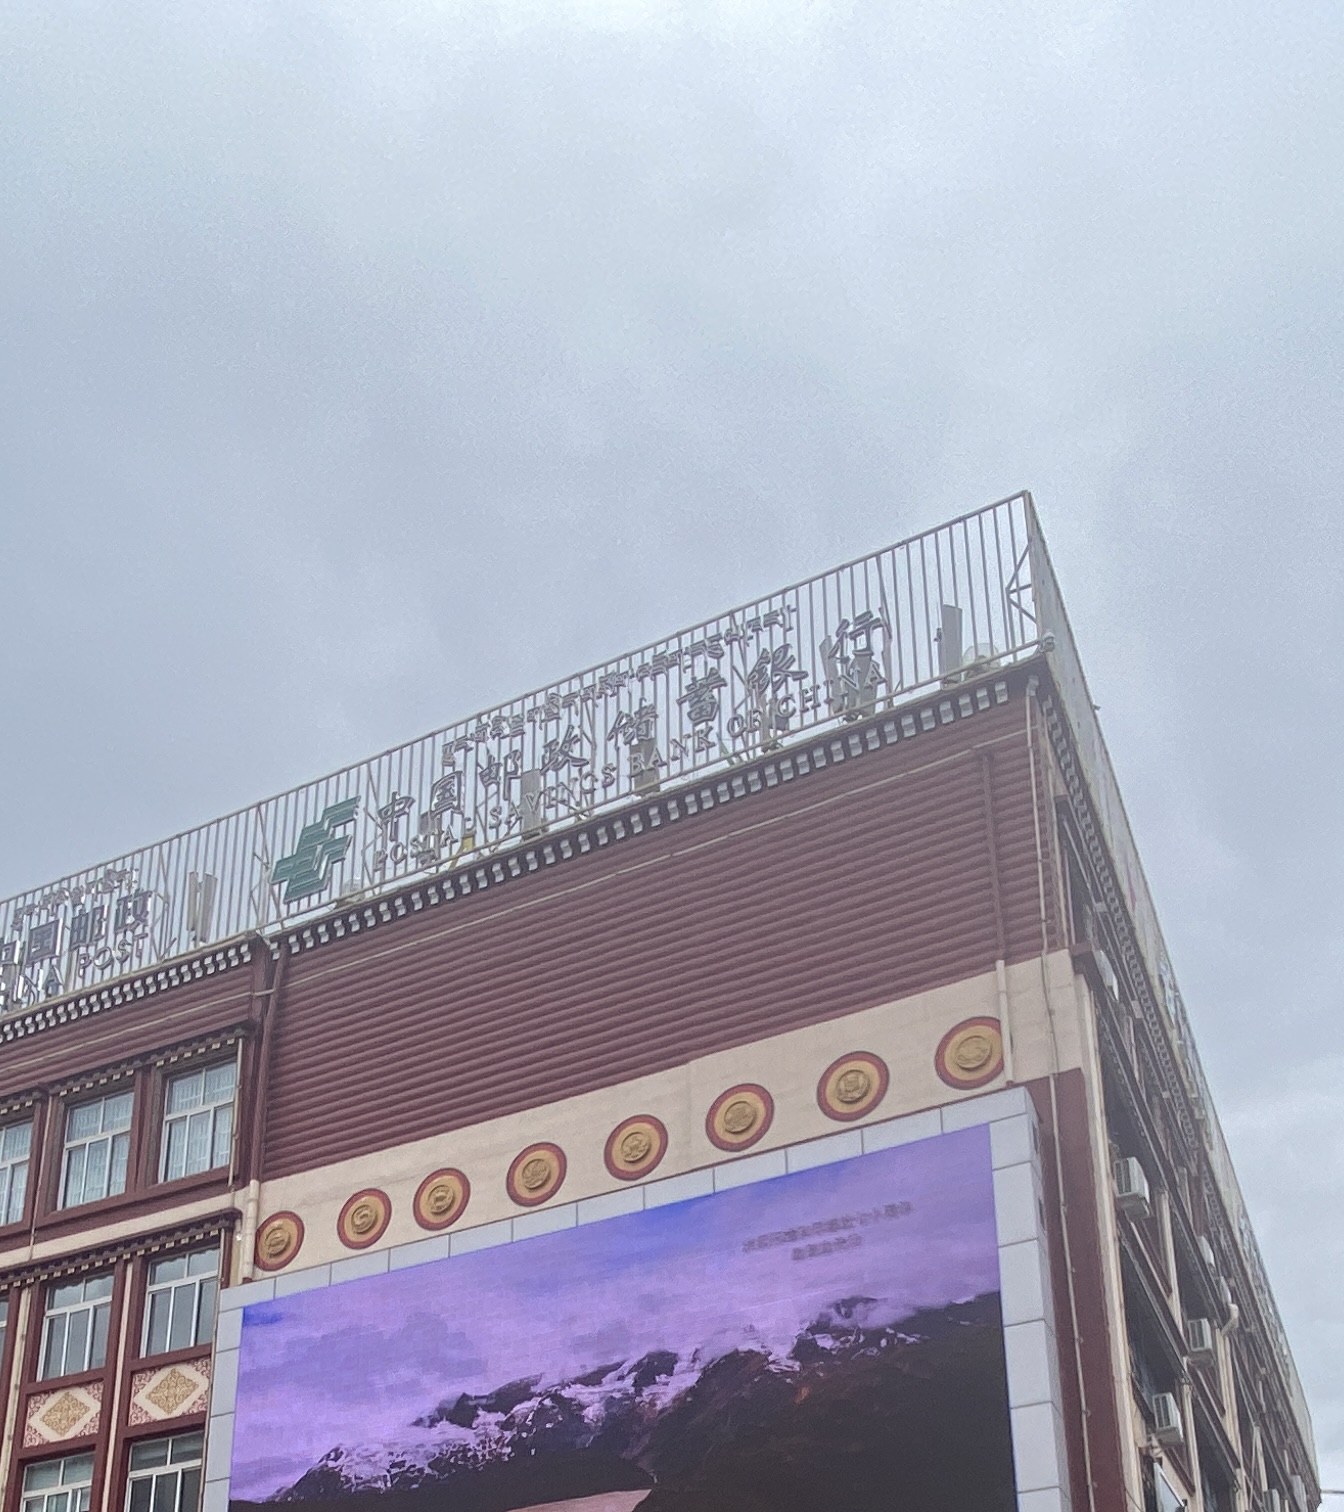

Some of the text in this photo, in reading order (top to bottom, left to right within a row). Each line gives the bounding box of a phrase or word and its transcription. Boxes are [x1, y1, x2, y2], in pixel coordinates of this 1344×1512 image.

[377, 608, 884, 843] 中国邮政储蓄银行
[627, 725, 717, 779] BANK
